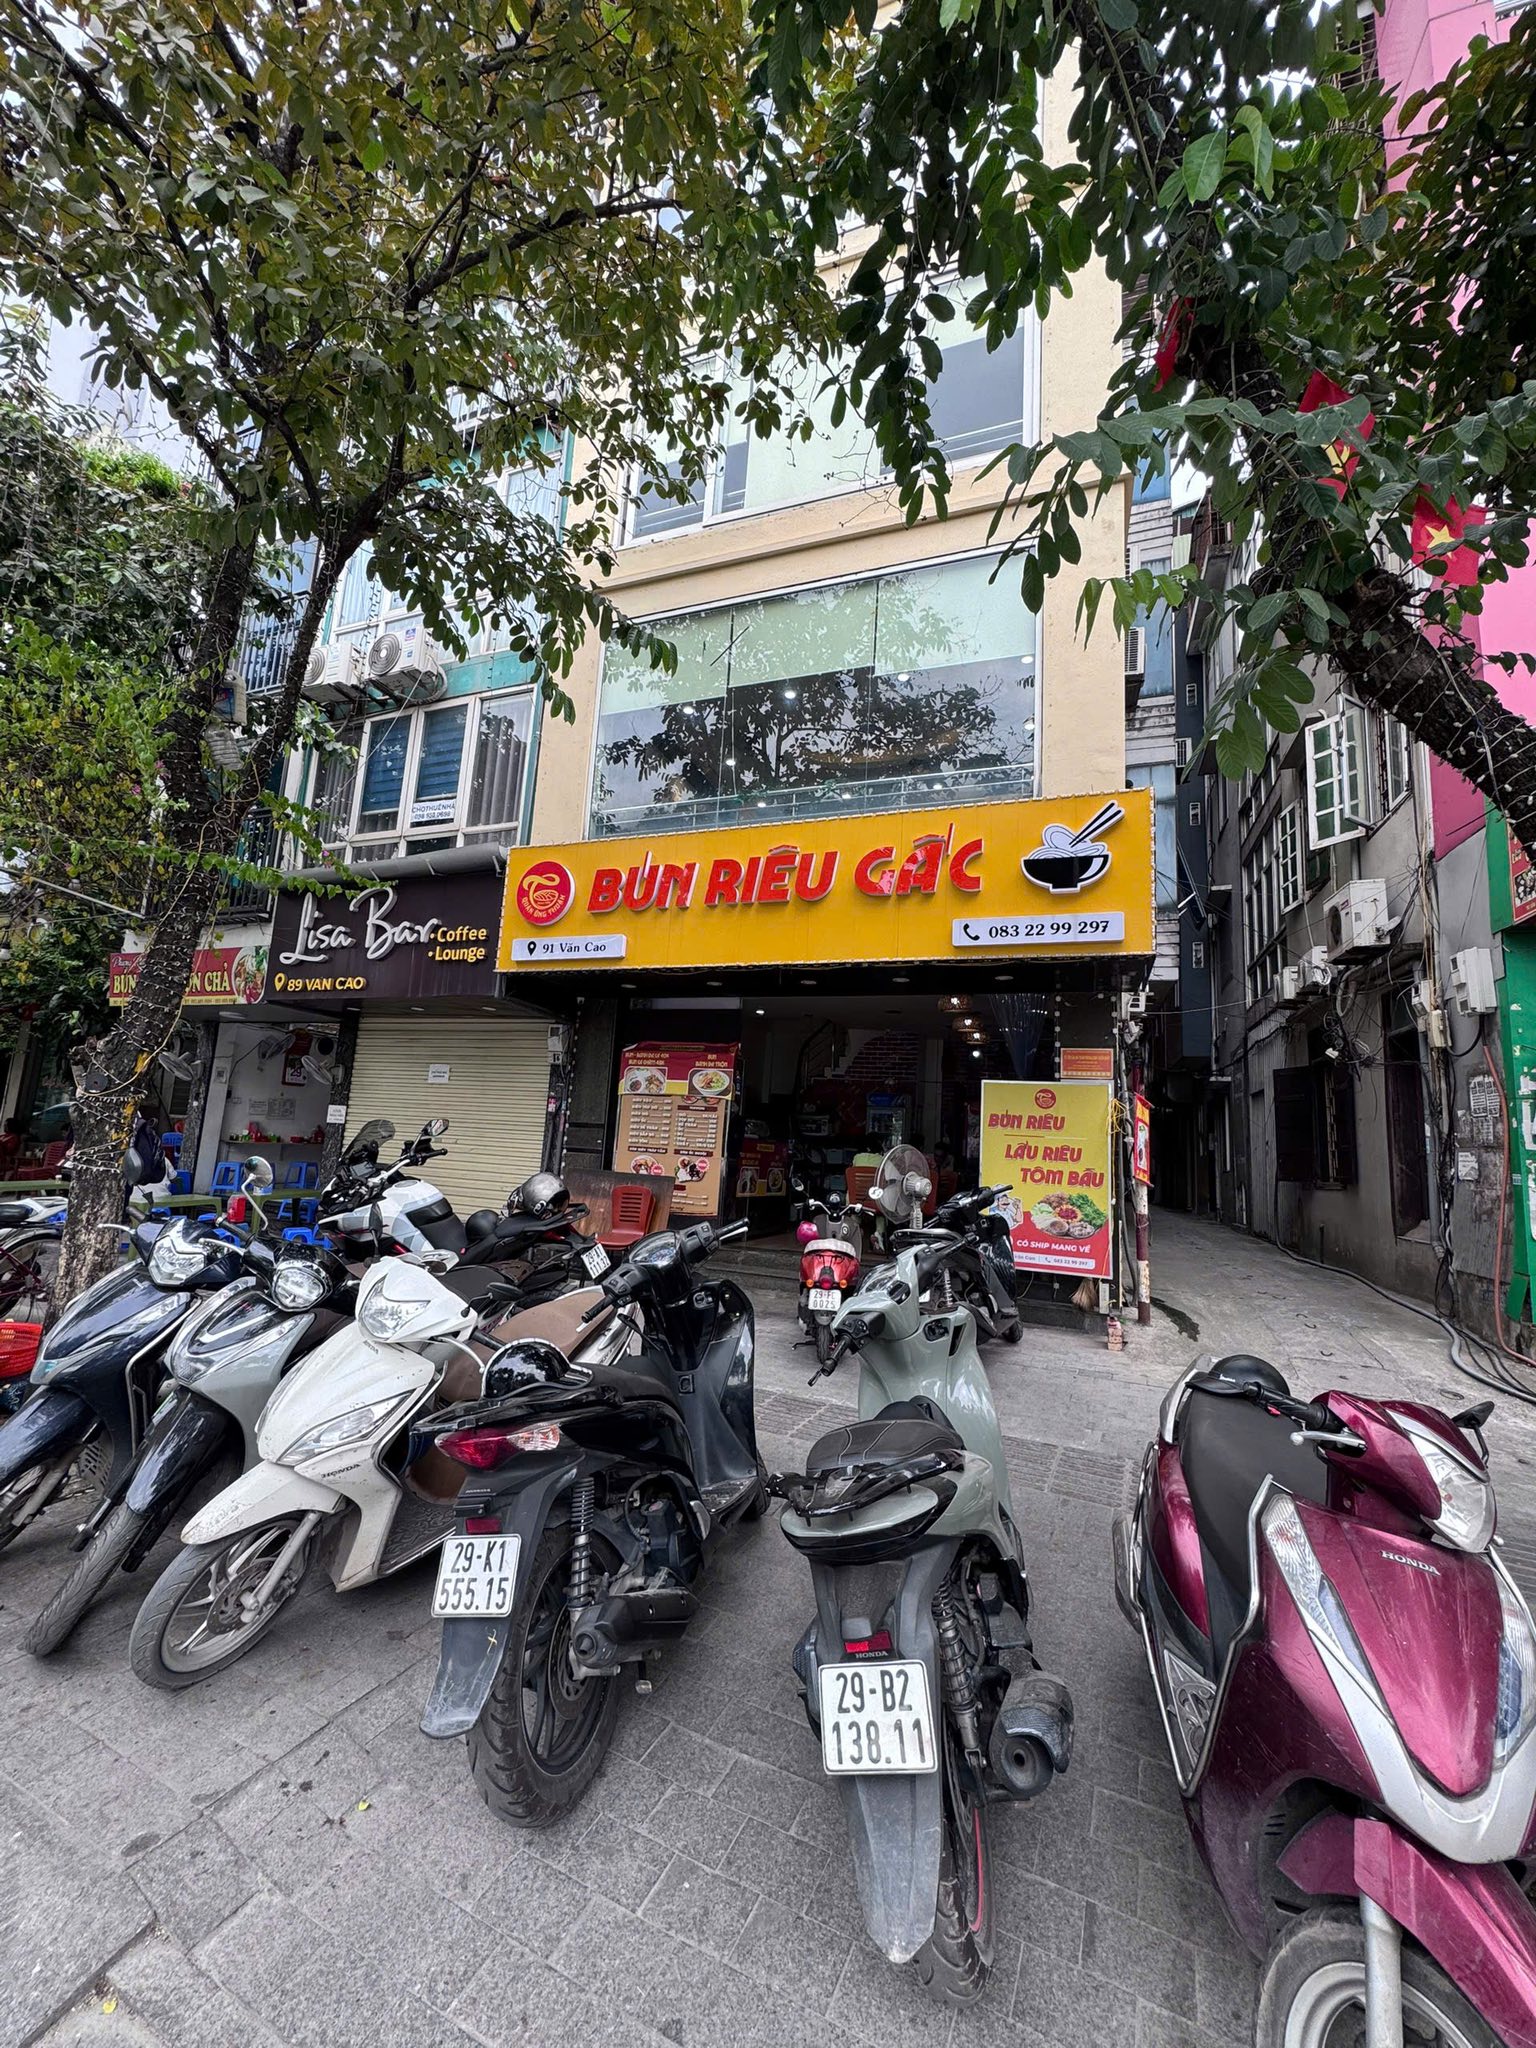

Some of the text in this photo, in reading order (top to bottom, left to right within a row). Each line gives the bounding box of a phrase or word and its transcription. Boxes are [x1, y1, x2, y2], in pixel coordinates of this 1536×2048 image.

[587, 822, 984, 914] BÚN RIÊU GẤC
[279, 886, 441, 965] Lisa Bar
[436, 926, 488, 943] Coffee
[989, 920, 1110, 938] 083 22 99 297
[434, 946, 486, 963] Lounge
[542, 942, 606, 954] 91 Văn Cao
[204, 962, 231, 992] CHẢ
[287, 978, 303, 992] 89
[335, 976, 365, 990] CAO
[988, 1110, 1066, 1131] BÚN RIÊU
[1042, 1144, 1082, 1162] RIÊU
[1020, 1166, 1064, 1185] TÔM
[1030, 1241, 1050, 1249] SHIP
[1051, 1243, 1077, 1252] MANG
[321, 1464, 362, 1479] HONDA
[449, 1539, 506, 1574] 29-K1
[1381, 1550, 1441, 1576] HONDA
[438, 1577, 509, 1612] 555.15
[855, 1650, 889, 1659] HONDA
[834, 1669, 913, 1714] 29-B2
[831, 1717, 924, 1766] 138.11
